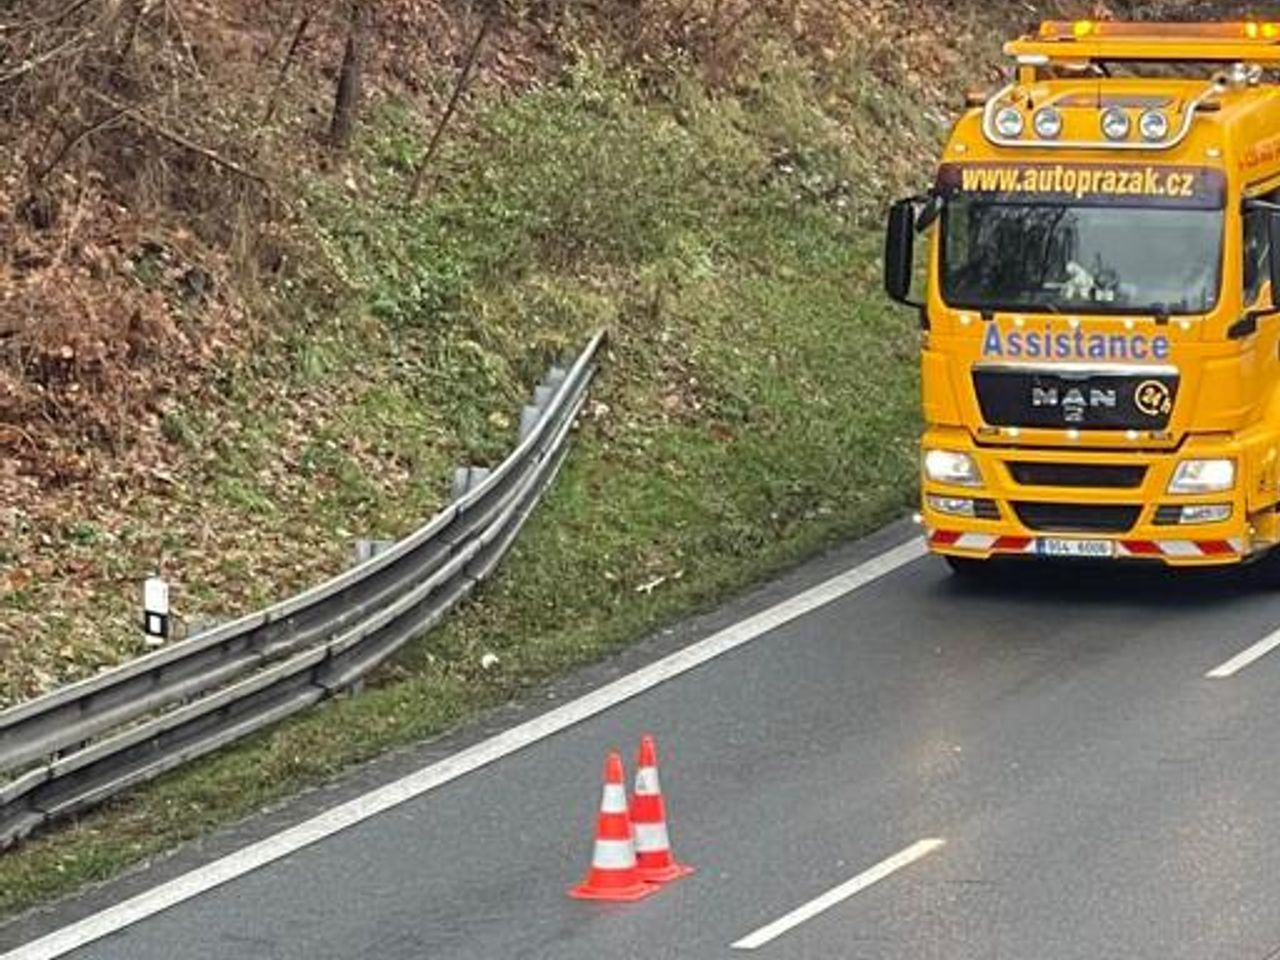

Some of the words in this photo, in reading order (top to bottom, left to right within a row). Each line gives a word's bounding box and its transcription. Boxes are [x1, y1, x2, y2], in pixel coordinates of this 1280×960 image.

[961, 166, 1194, 198] www.autoprazak.cz
[983, 322, 1169, 358] Assistance
[1032, 387, 1117, 406] MAN
